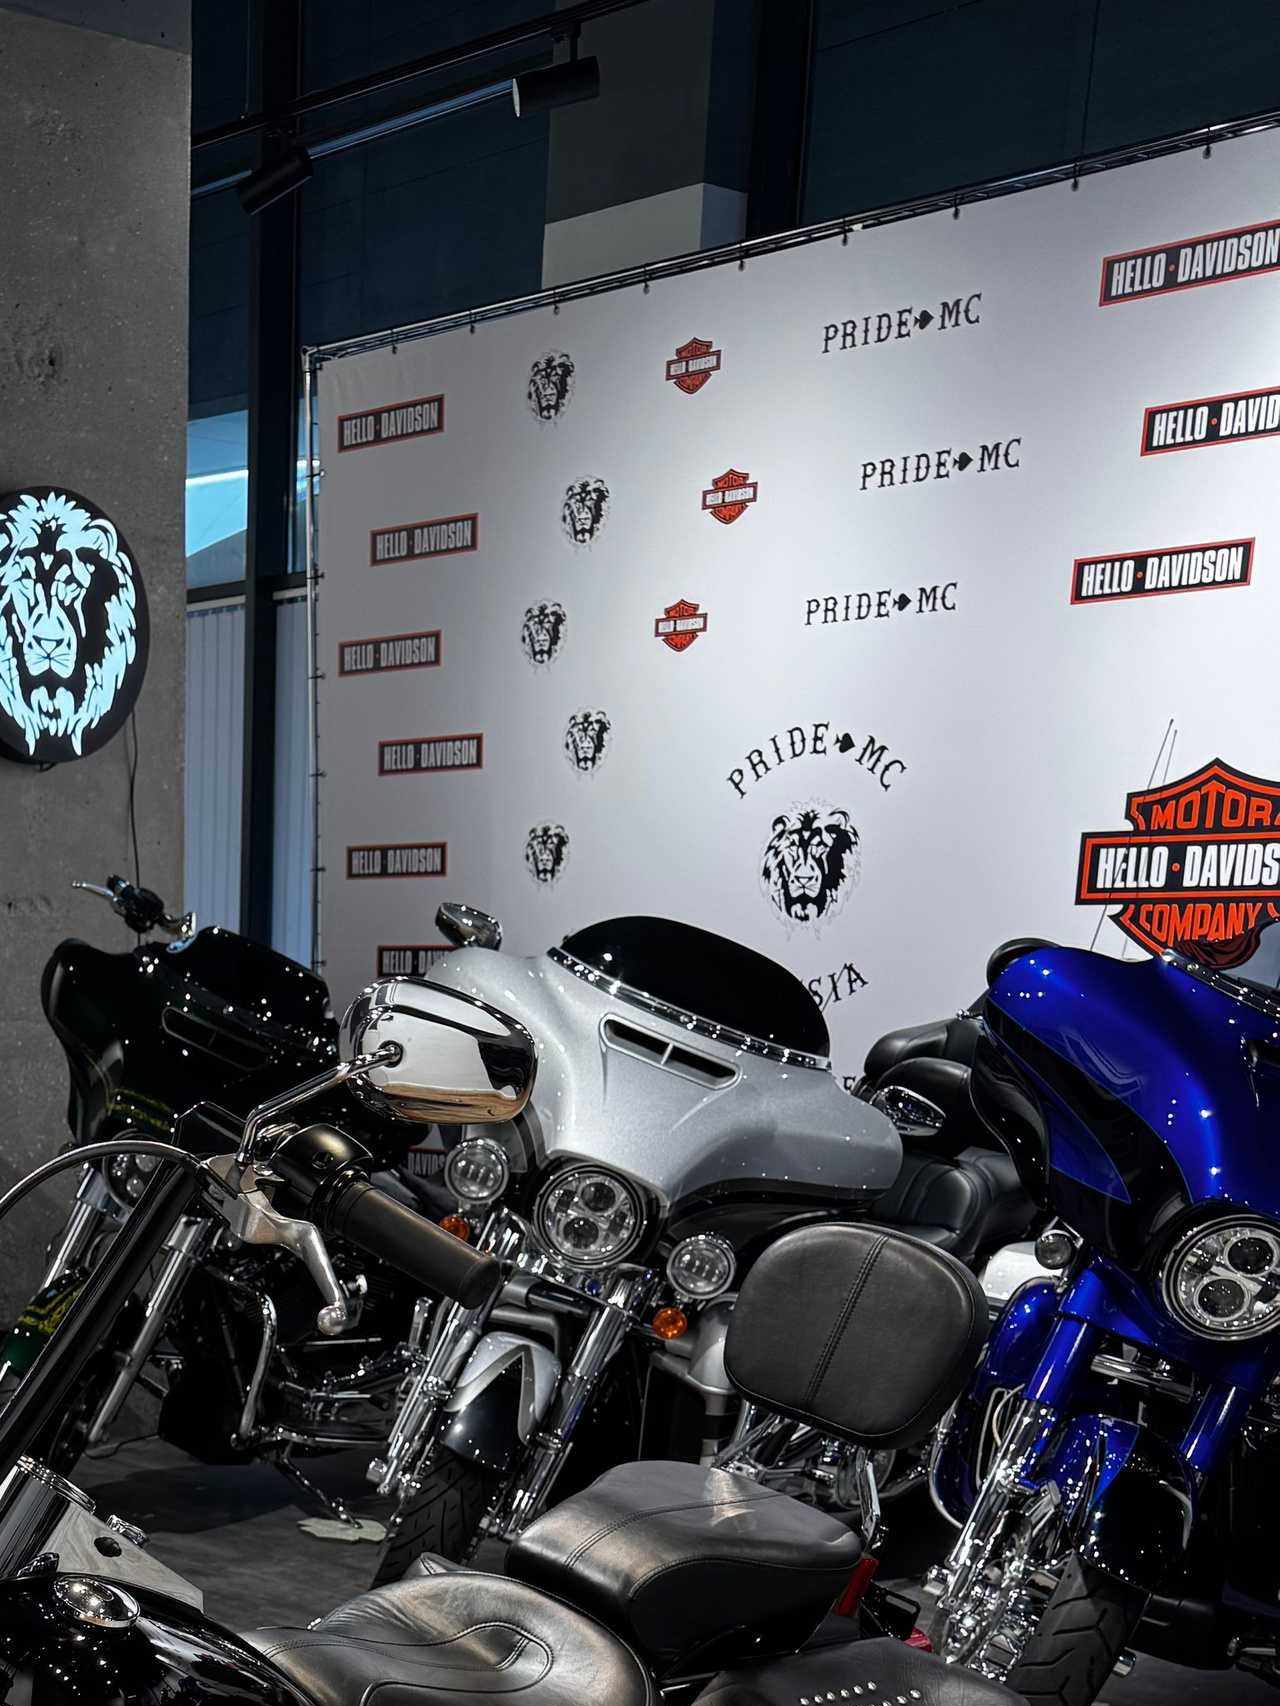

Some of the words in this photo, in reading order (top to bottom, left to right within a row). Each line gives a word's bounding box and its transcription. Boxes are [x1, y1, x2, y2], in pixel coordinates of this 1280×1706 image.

[1110, 252, 1167, 297] HELLO
[1177, 228, 1280, 283] DAVIDSON
[822, 306, 913, 353] PRIDE
[938, 292, 982, 330] MC
[343, 415, 375, 446] HELLO
[380, 402, 438, 438] DAVIDSON
[1152, 405, 1209, 447] HELLO
[1219, 394, 1280, 436] DAVID
[859, 447, 952, 490] PRIDE
[977, 437, 1022, 473] MC
[376, 531, 407, 560] HELLO
[413, 520, 472, 554] DAVIDSON
[1081, 559, 1135, 597] HELLO
[1144, 546, 1244, 590] DAVIDSON
[804, 588, 892, 626] PRIDE
[915, 582, 958, 613] MC
[343, 644, 374, 671] HELLO
[380, 636, 436, 667] DAVIDSON
[383, 744, 414, 771] HELLO
[420, 739, 477, 768] DAVIDSON
[726, 721, 830, 799] PRIDE
[854, 734, 907, 792] MC
[1150, 779, 1272, 830] MOTOR
[351, 850, 381, 875] HELLO
[387, 847, 442, 873] DAVIDSON
[1096, 846, 1169, 888] HELLO
[1182, 843, 1280, 887] DAVIDS
[1139, 902, 1263, 947] COMPANY
[382, 950, 412, 974] HELLO
